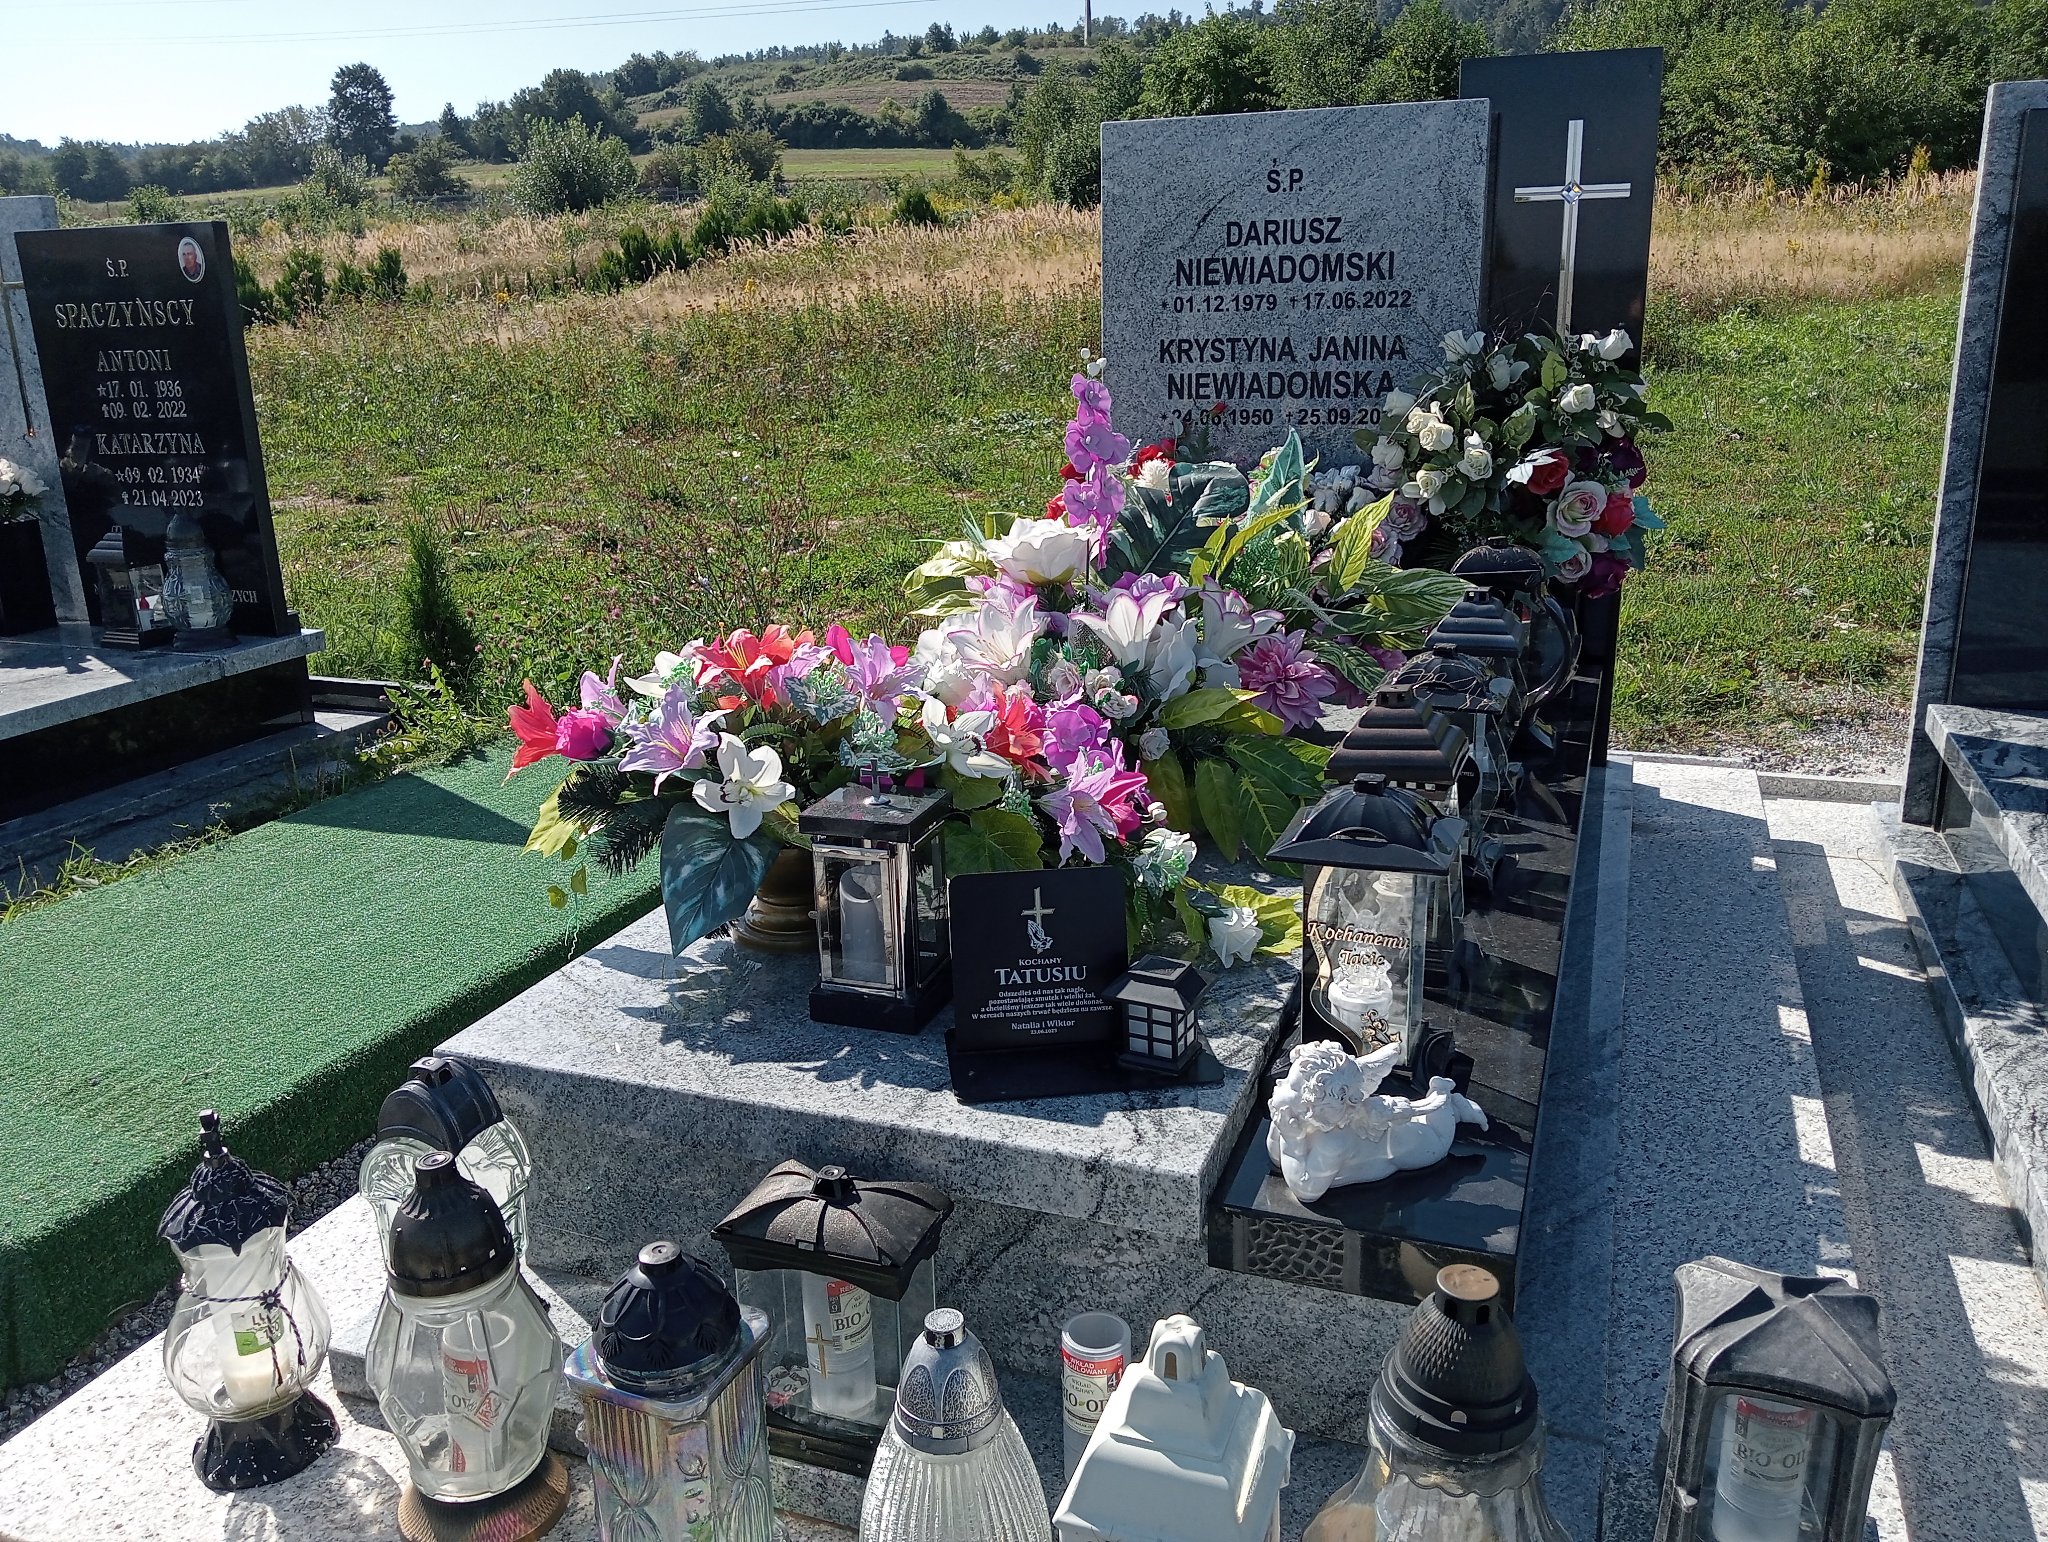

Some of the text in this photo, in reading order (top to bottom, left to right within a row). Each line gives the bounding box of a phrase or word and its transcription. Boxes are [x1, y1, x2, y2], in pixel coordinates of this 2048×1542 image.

[1225, 217, 1343, 248] DARIUSZ
[1175, 251, 1395, 287] NIEWIADOMSKI
[54, 297, 195, 329] SPACZYŃSCY
[1159, 334, 1408, 364] KRYSTYNA JANINA
[97, 349, 172, 372] ANTONI
[154, 380, 183, 398] 1936
[1167, 369, 1396, 400] NIEWIADOMSKA
[156, 400, 188, 418] 2022
[1299, 407, 1382, 426] 25.09.20
[96, 432, 206, 455] KATARZYNA
[170, 466, 201, 484] 1934
[1306, 920, 1410, 950] Kochanemu
[1019, 957, 1062, 966] KOCHANY
[1340, 947, 1385, 966] Tacie
[994, 965, 1087, 985] TATUSIU
[1032, 988, 1041, 996] od
[1042, 988, 1054, 996] nas
[1054, 987, 1066, 995] tak
[1034, 994, 1059, 1002] smutek
[1064, 992, 1084, 1000] wielki
[979, 1011, 1005, 1019] sercach
[1005, 1009, 1031, 1018] naszych
[1021, 1002, 1044, 1011] jeszcze
[1011, 1021, 1040, 1030] Natalia
[1046, 1019, 1075, 1028] Wiktor
[834, 1312, 861, 1331] BIO
[1064, 1387, 1108, 1412] IO OI
